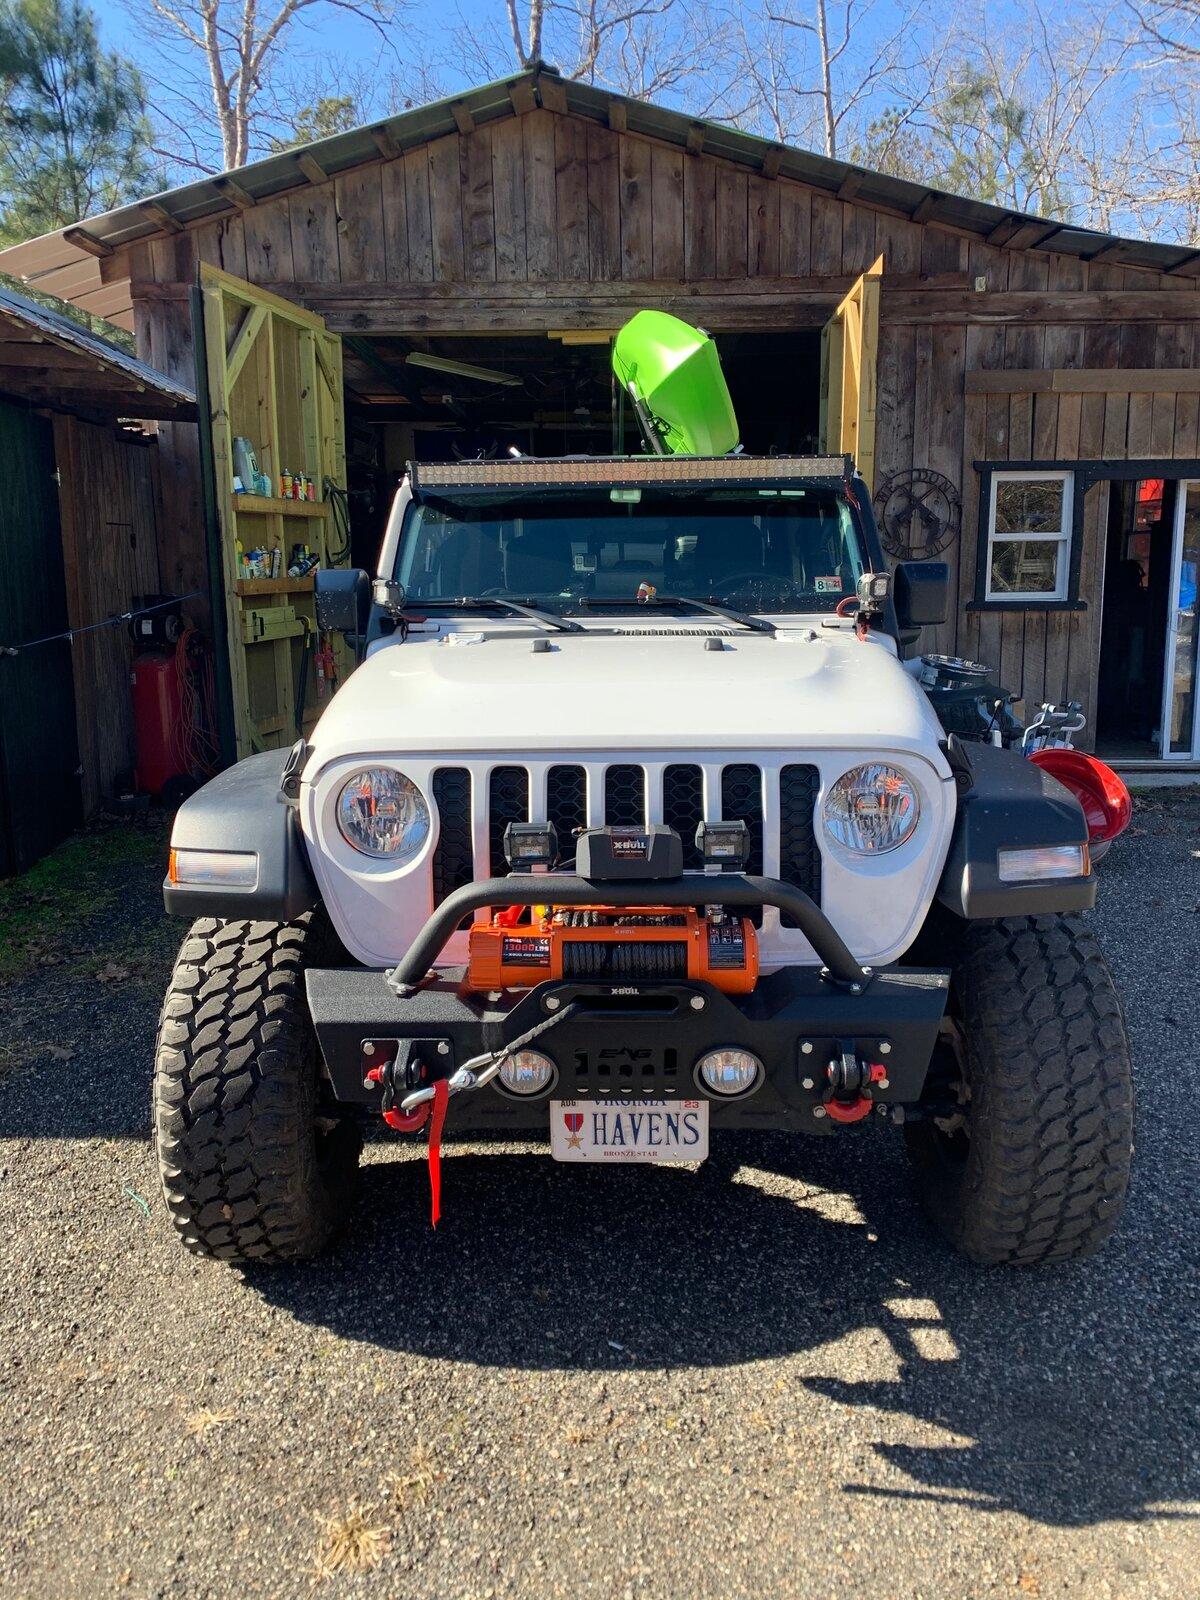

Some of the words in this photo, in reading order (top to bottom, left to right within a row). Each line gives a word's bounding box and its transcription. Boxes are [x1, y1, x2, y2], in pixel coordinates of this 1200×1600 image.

[817, 580, 825, 590] 8
[613, 840, 647, 849] X-BULL
[611, 987, 640, 995] X-BULL
[684, 1100, 700, 1109] 23
[592, 1113, 700, 1145] HAVENS
